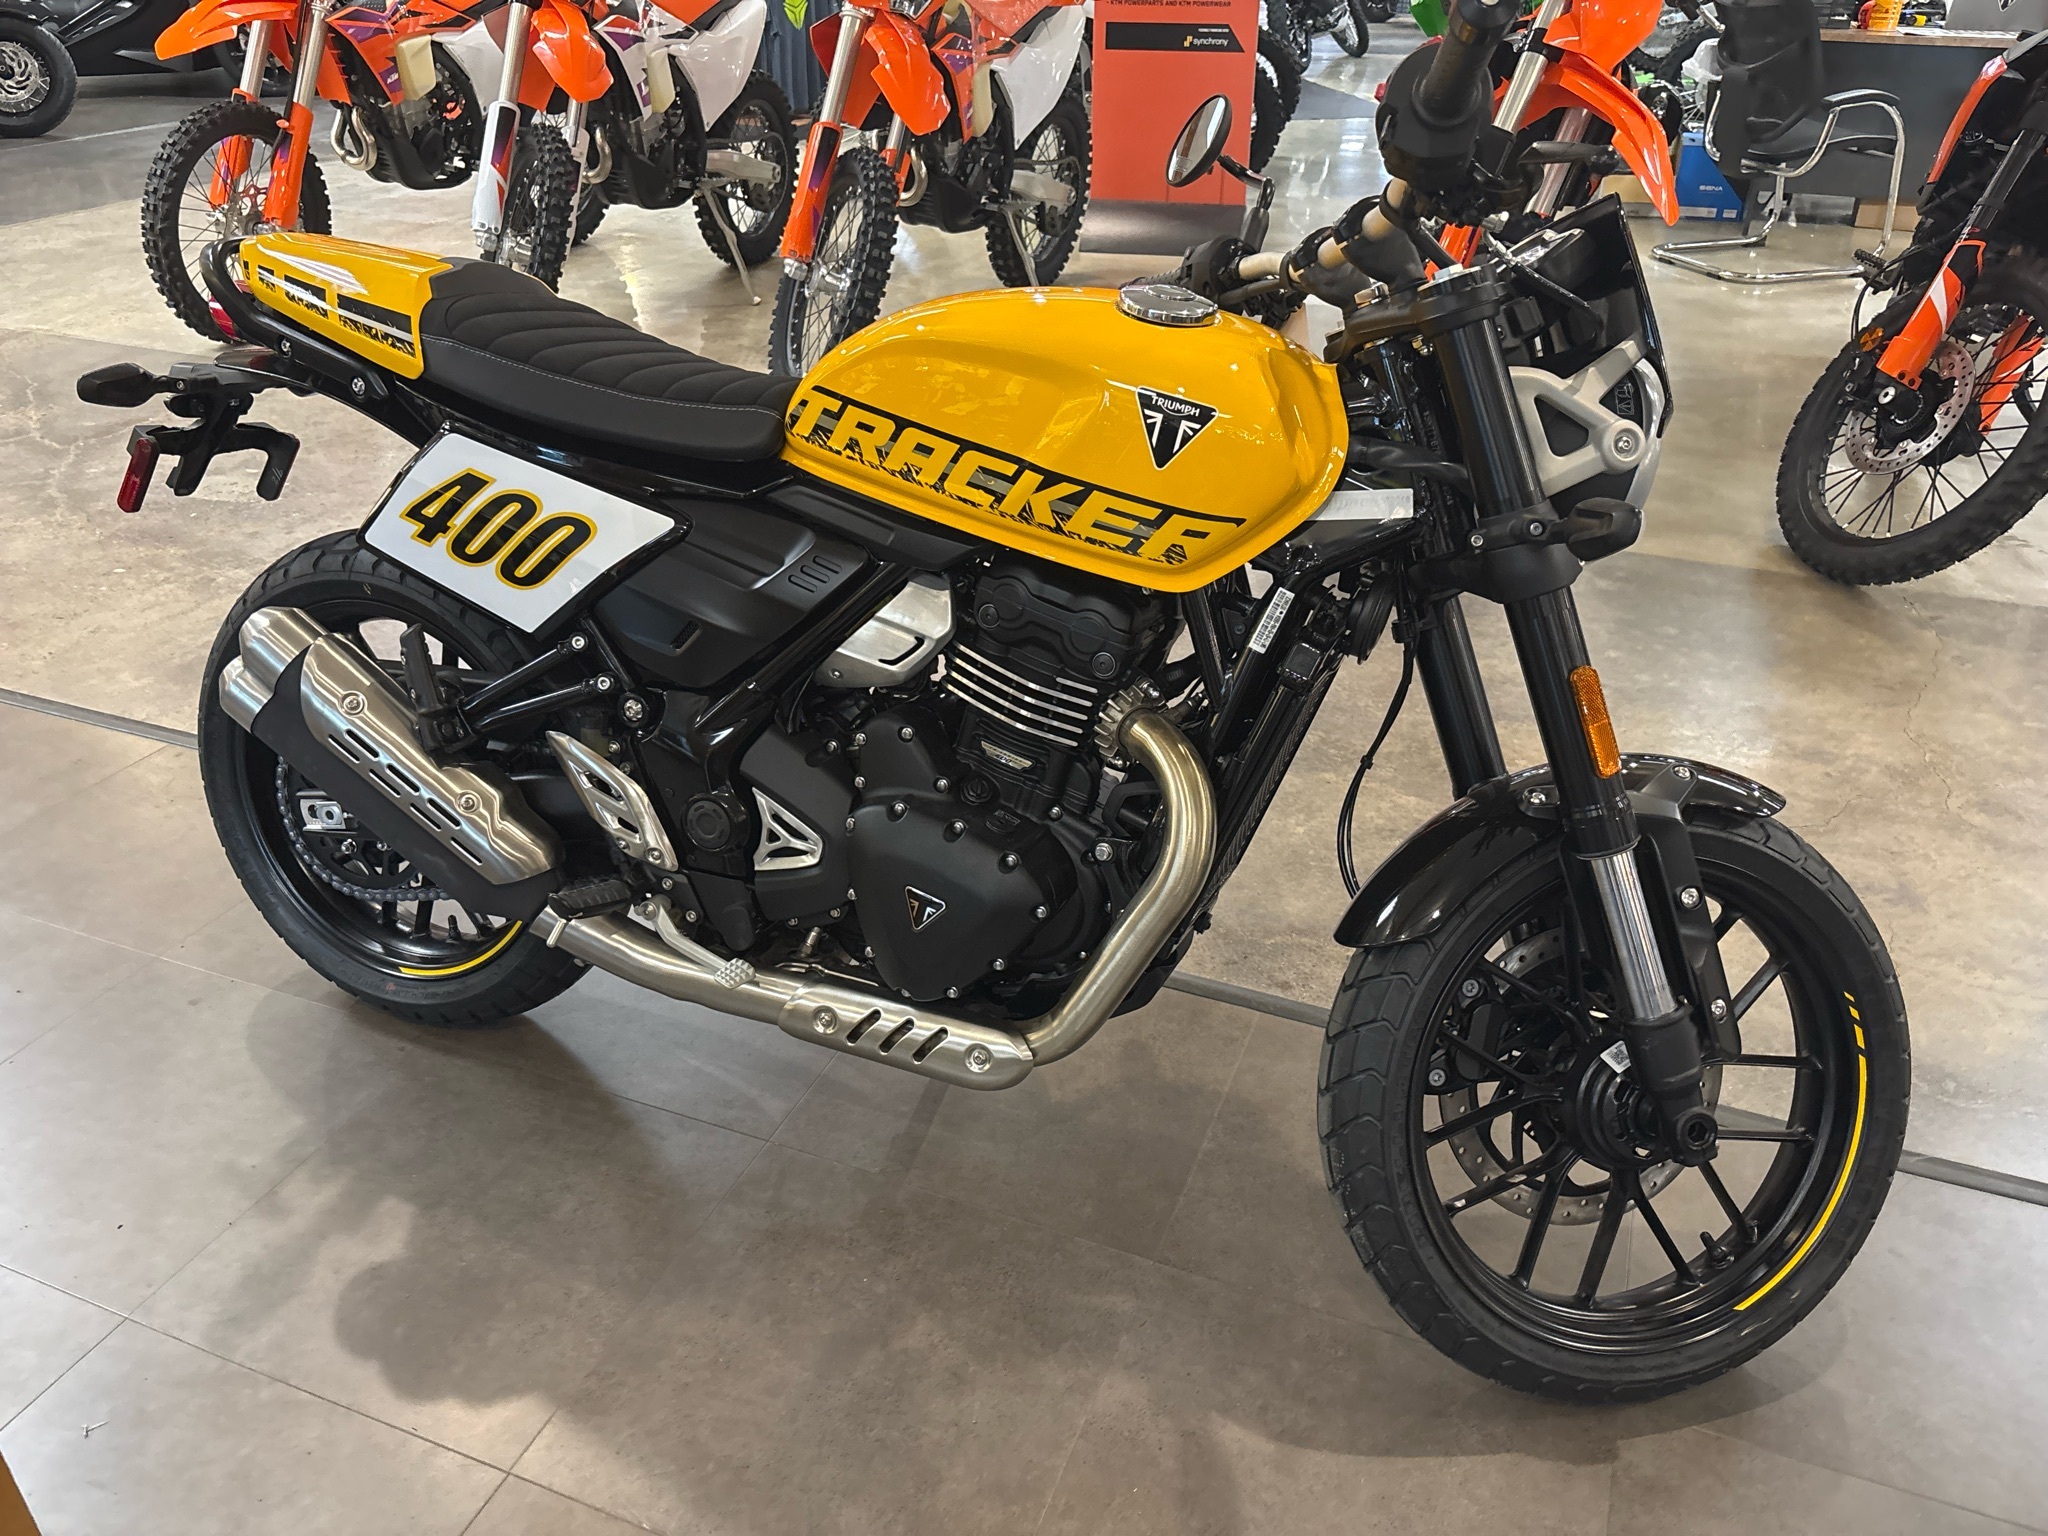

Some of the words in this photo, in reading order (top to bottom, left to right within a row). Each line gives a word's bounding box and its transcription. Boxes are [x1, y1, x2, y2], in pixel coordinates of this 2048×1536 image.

[1193, 37, 1229, 47] synchrony
[1698, 184, 1723, 192] SENA
[1151, 395, 1200, 417] TRIUMPH
[790, 388, 1243, 564] TRACKER
[399, 467, 598, 590] 400
